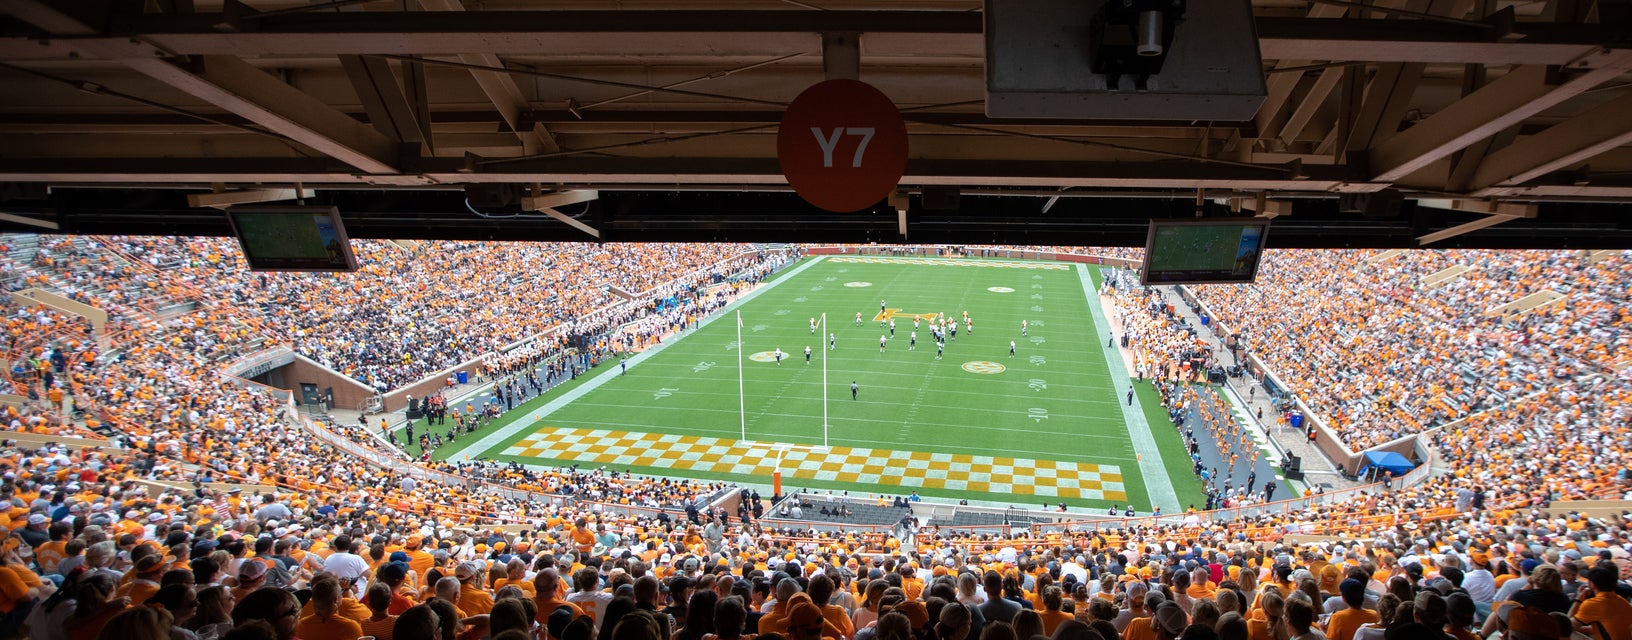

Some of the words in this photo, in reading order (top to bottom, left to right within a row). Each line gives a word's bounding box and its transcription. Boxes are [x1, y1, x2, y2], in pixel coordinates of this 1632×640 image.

[810, 127, 875, 167] Y7
[653, 387, 679, 398] 10
[1028, 408, 1049, 419] 10
